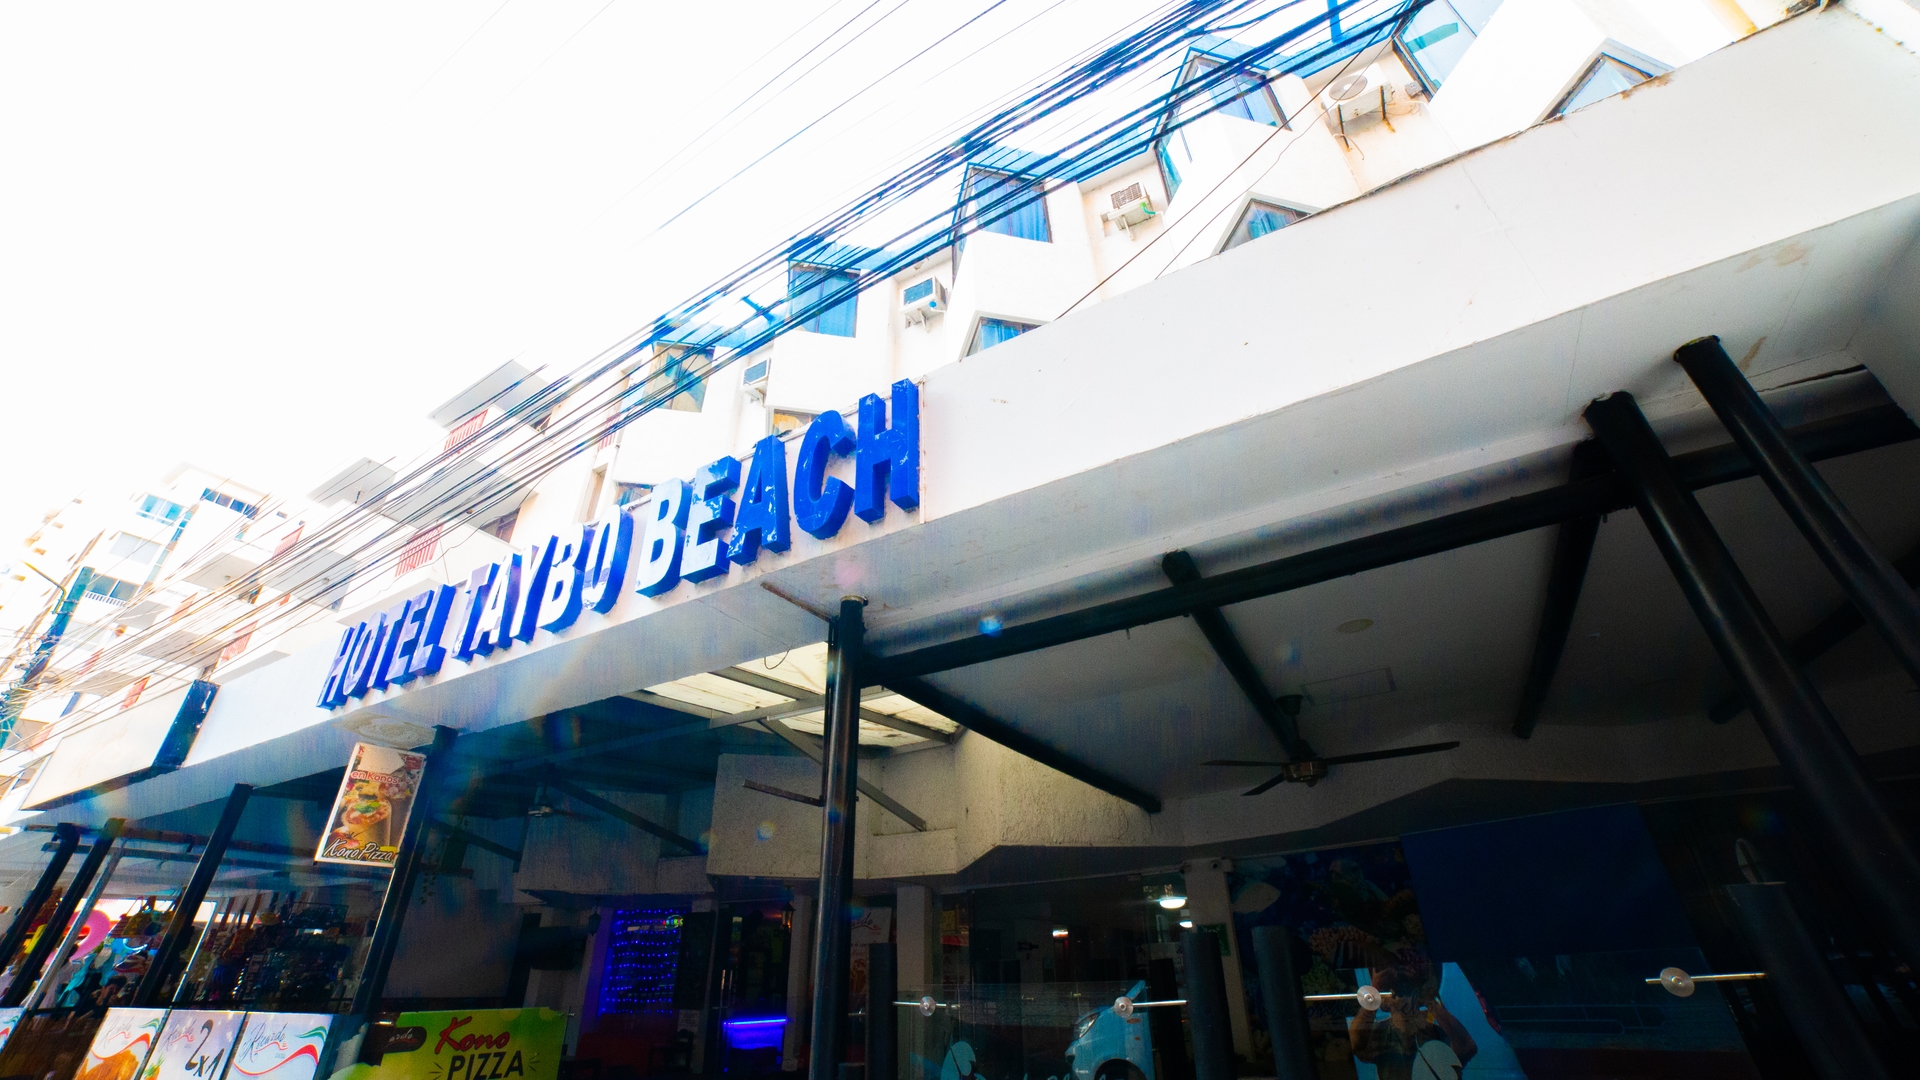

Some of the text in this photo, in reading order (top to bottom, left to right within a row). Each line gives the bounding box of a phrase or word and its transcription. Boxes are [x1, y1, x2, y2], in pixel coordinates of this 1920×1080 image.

[316, 378, 920, 712] HOTEL TAYBO BEACH
[351, 770, 399, 785] en Konos
[323, 837, 394, 862] Kono Pizza
[435, 1015, 511, 1055] Kono
[447, 1050, 524, 1080] PIZZA
